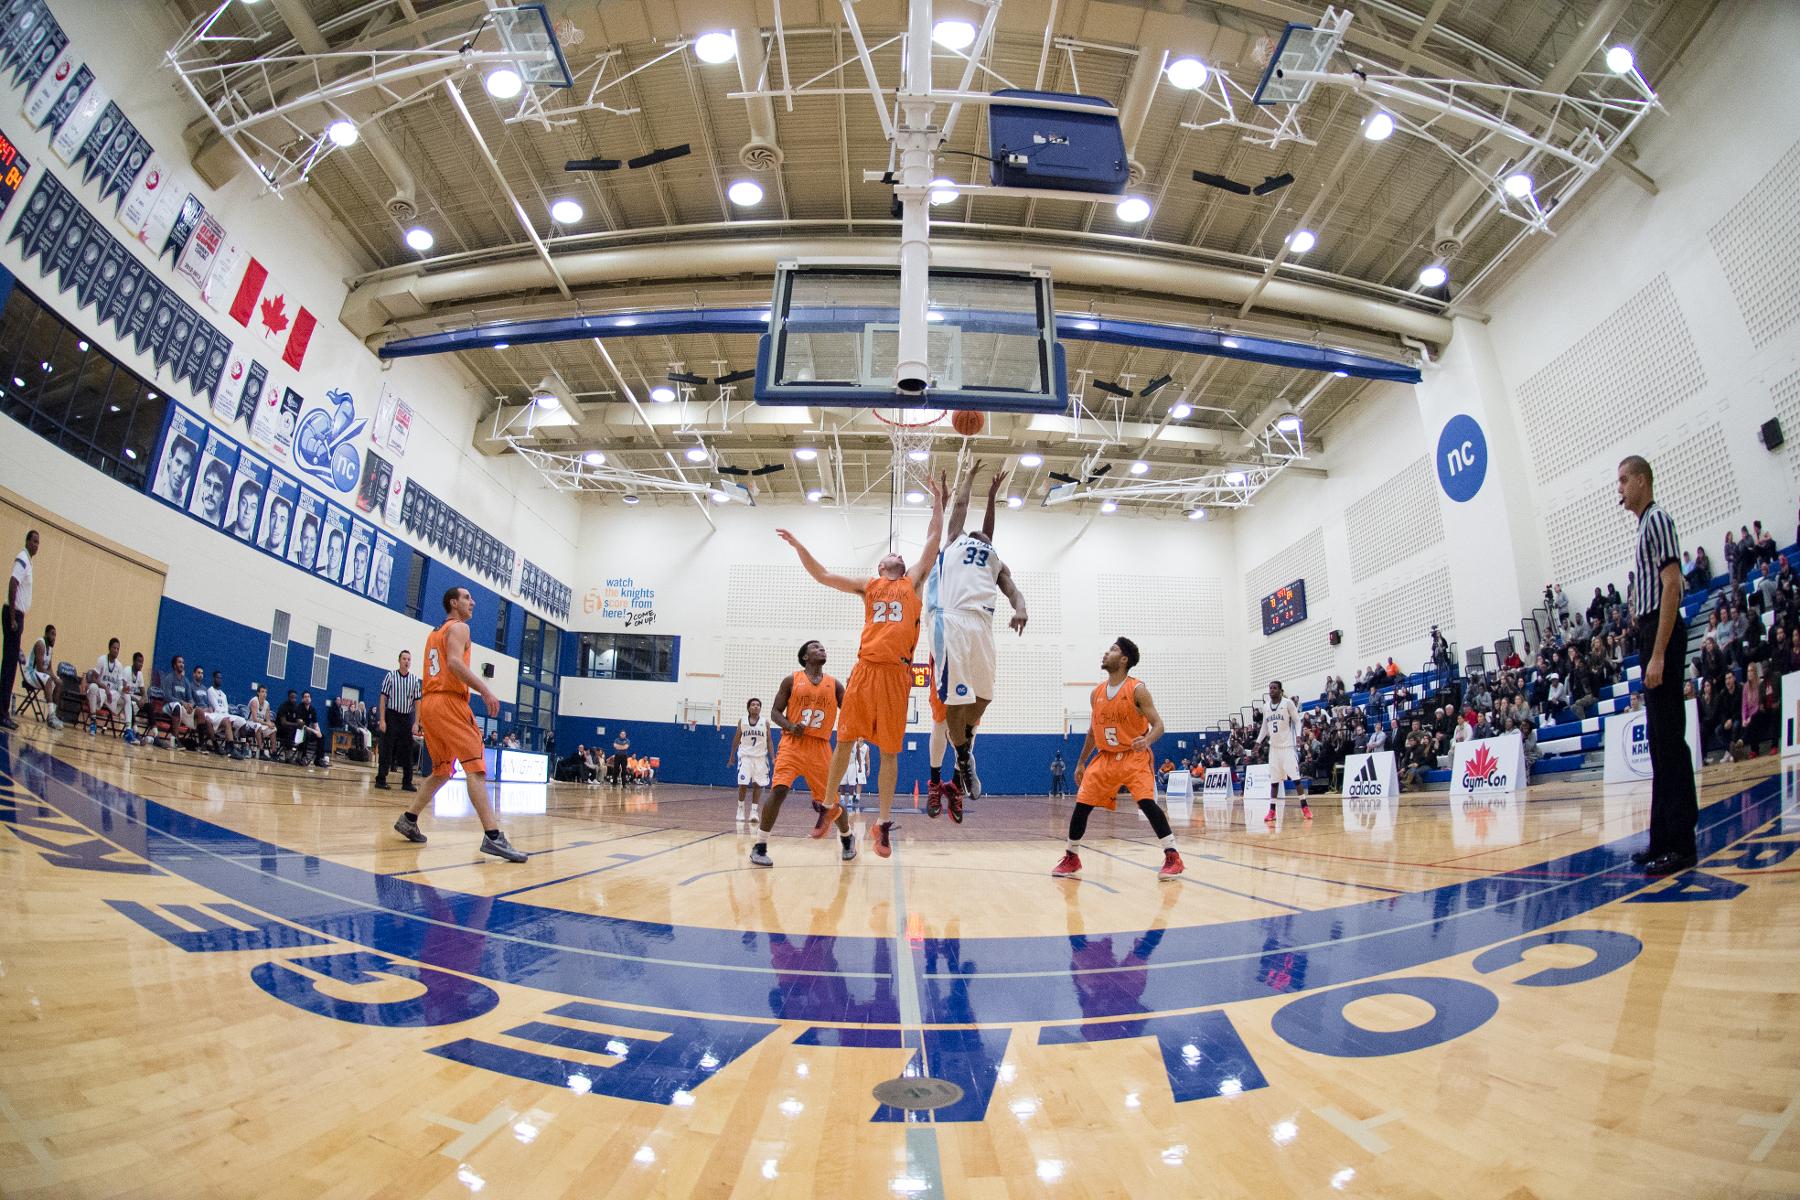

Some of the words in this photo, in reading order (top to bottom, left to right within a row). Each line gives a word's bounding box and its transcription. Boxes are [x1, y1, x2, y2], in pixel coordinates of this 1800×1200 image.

[200, 224, 220, 246] OCAA
[1447, 440, 1475, 477] nc
[336, 456, 356, 480] nc
[963, 546, 990, 567] 33
[606, 578, 633, 587] watch
[605, 588, 618, 597] the
[621, 588, 655, 600] knights
[604, 599, 629, 608] score
[631, 598, 652, 608] from
[602, 608, 627, 618] here!
[633, 610, 655, 620] COME
[872, 600, 904, 623] 23
[428, 647, 441, 678] 3
[912, 667, 930, 675] 4:47
[800, 708, 826, 729] 32
[1272, 721, 1279, 733] 5
[751, 737, 757, 747] 7
[1104, 726, 1120, 748] 5
[1205, 773, 1228, 789] OCAA
[1349, 781, 1382, 796] adidas
[1462, 770, 1507, 793] Gym-Con
